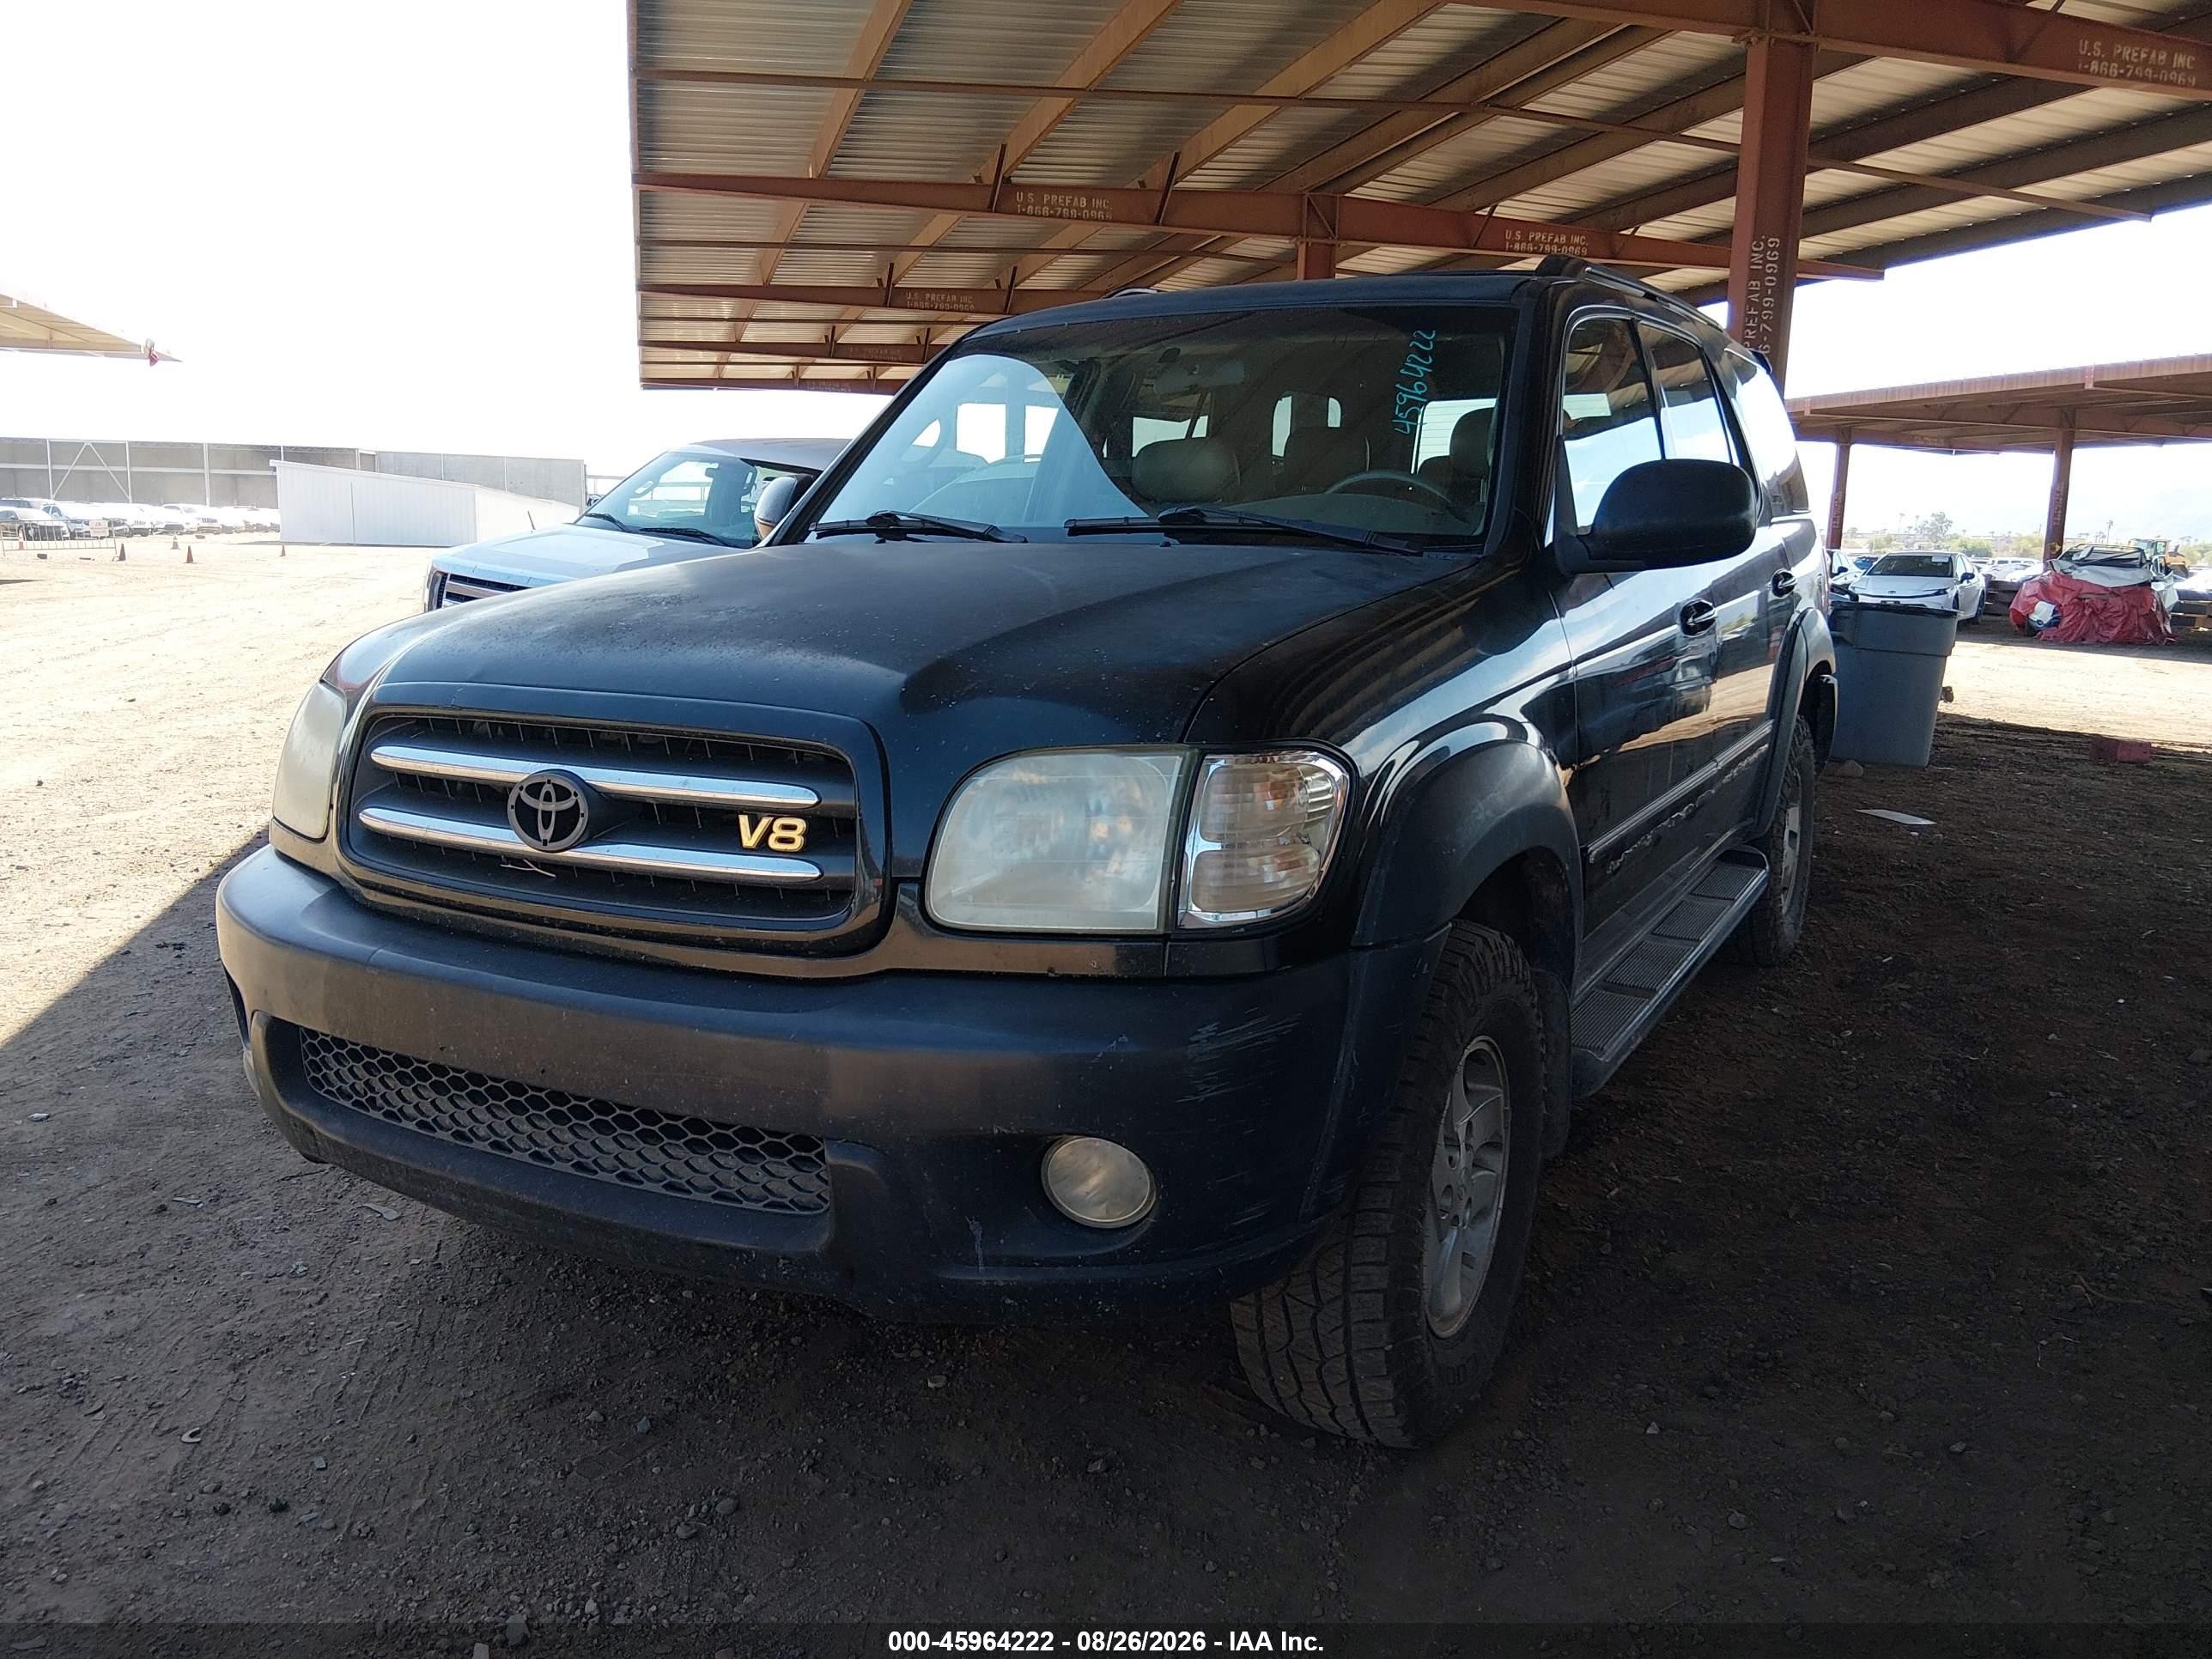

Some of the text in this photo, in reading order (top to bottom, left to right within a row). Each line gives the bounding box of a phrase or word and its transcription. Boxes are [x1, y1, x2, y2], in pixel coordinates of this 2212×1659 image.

[2113, 45, 2168, 65] PREFAB
[1043, 194, 1087, 208] PREFAB
[1528, 232, 1566, 244] PREFAB
[1571, 234, 1589, 246] INC.
[1750, 234, 1765, 270] INC.
[1391, 330, 1436, 434] 45964222
[738, 814, 806, 852] V8
